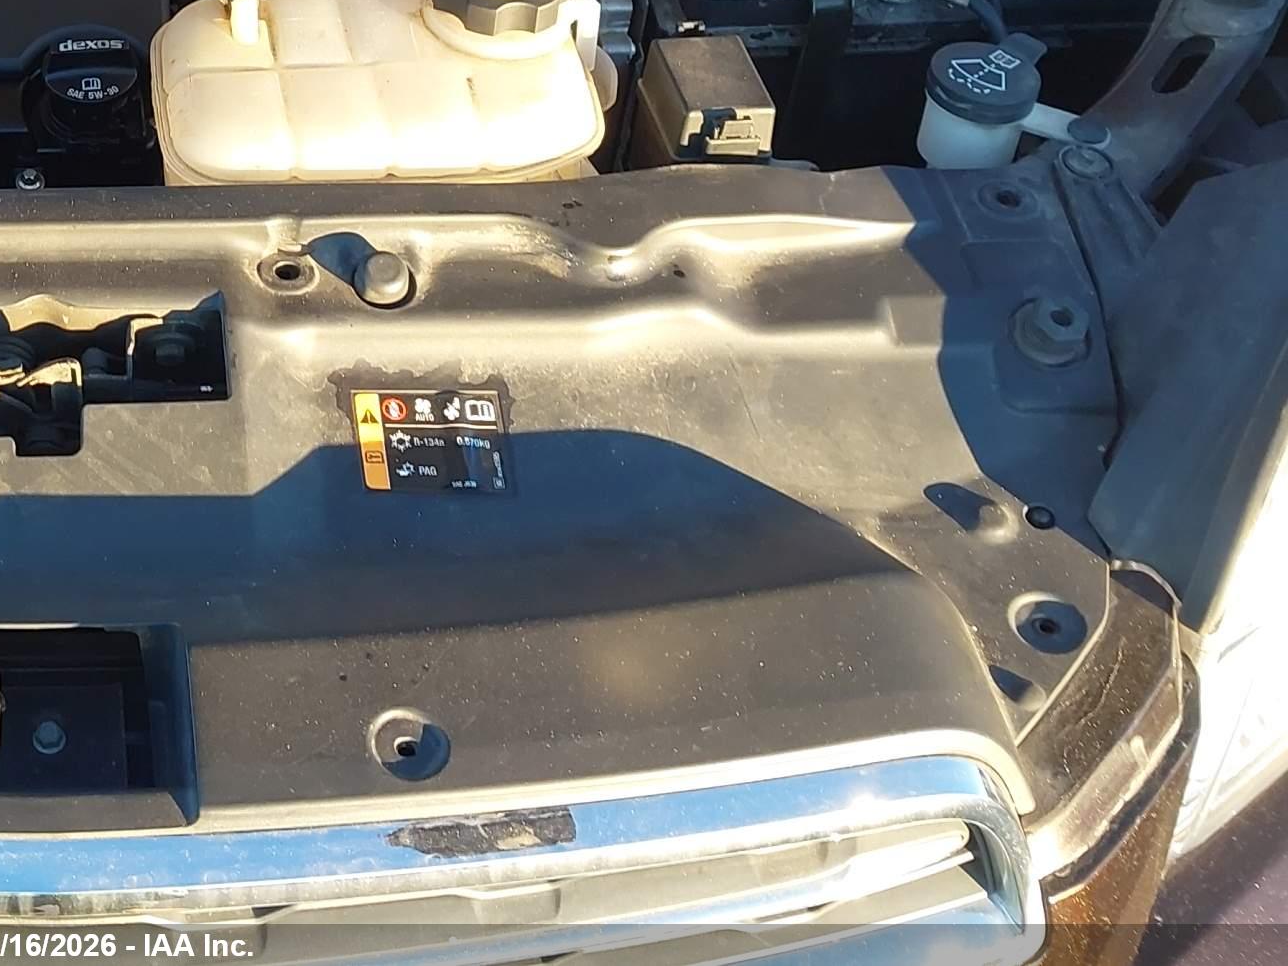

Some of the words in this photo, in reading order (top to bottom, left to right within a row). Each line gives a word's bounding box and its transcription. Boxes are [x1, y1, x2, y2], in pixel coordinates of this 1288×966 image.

[58, 39, 125, 52] dexos
[66, 88, 85, 100] SAE
[415, 412, 435, 422] AUTO
